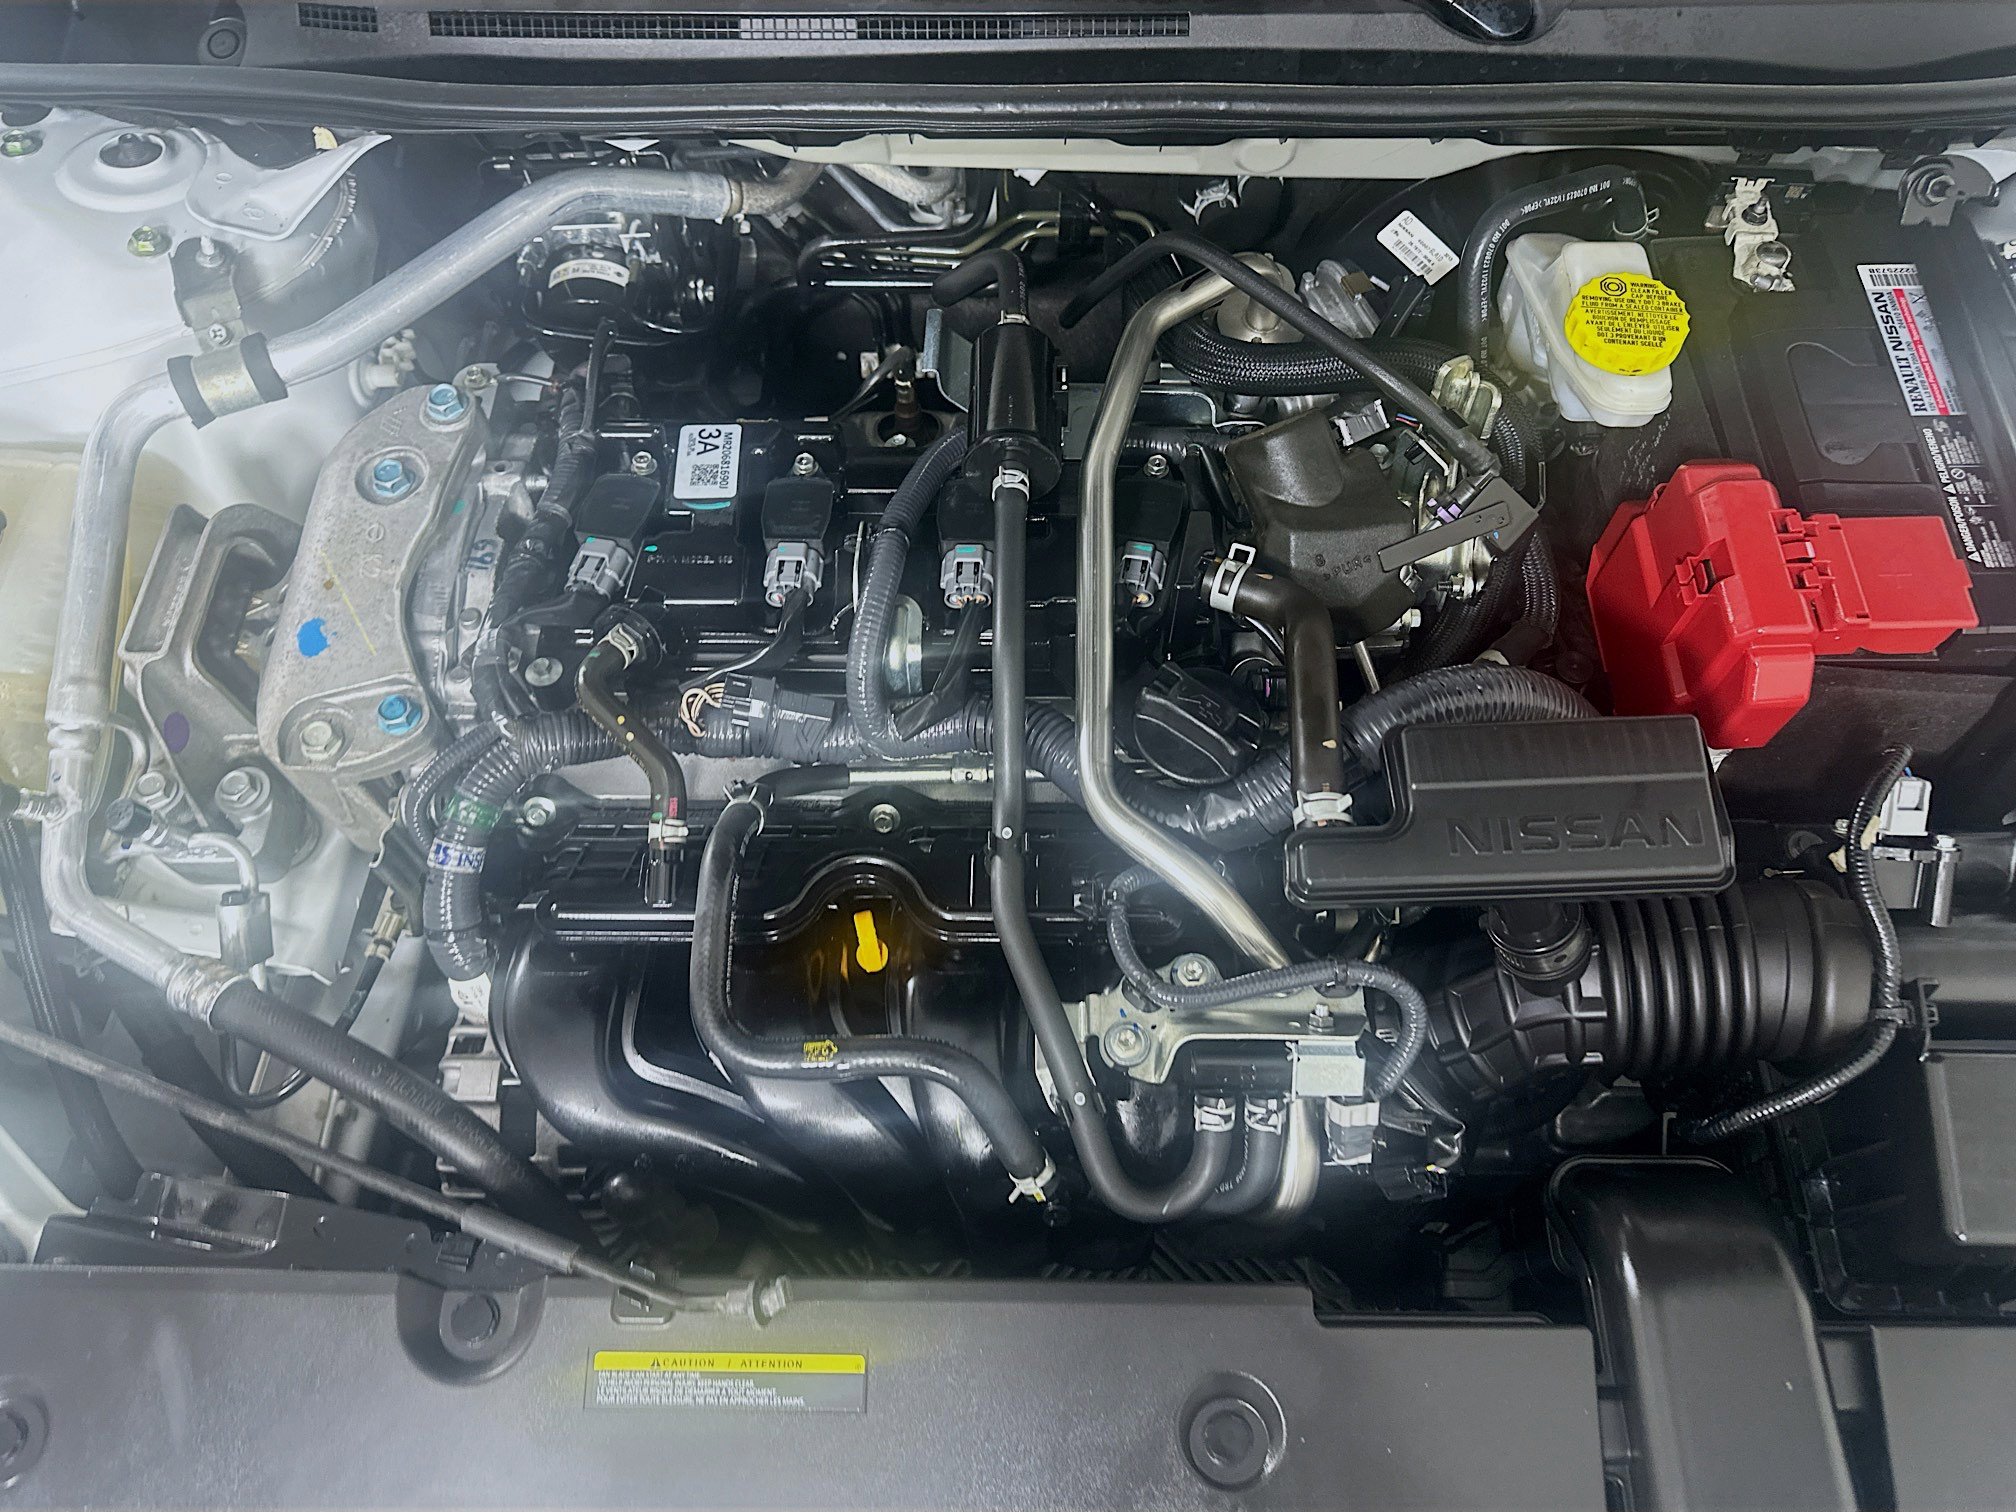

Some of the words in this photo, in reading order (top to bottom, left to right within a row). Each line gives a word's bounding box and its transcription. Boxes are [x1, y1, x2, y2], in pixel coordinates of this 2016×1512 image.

[1599, 179, 1610, 191] DOT
[1871, 291, 1905, 352] NISSAN
[1894, 354, 1927, 412] RENAULT
[697, 428, 720, 455] 3A
[719, 432, 732, 488] MR20681690J
[1922, 428, 1950, 483] PELIGRO/VENENO
[1947, 496, 1975, 551] DANGER/POISON
[1447, 809, 1704, 856] NISSAN
[663, 1358, 715, 1367] CAUTION
[741, 1360, 803, 1368] ATTENTION
